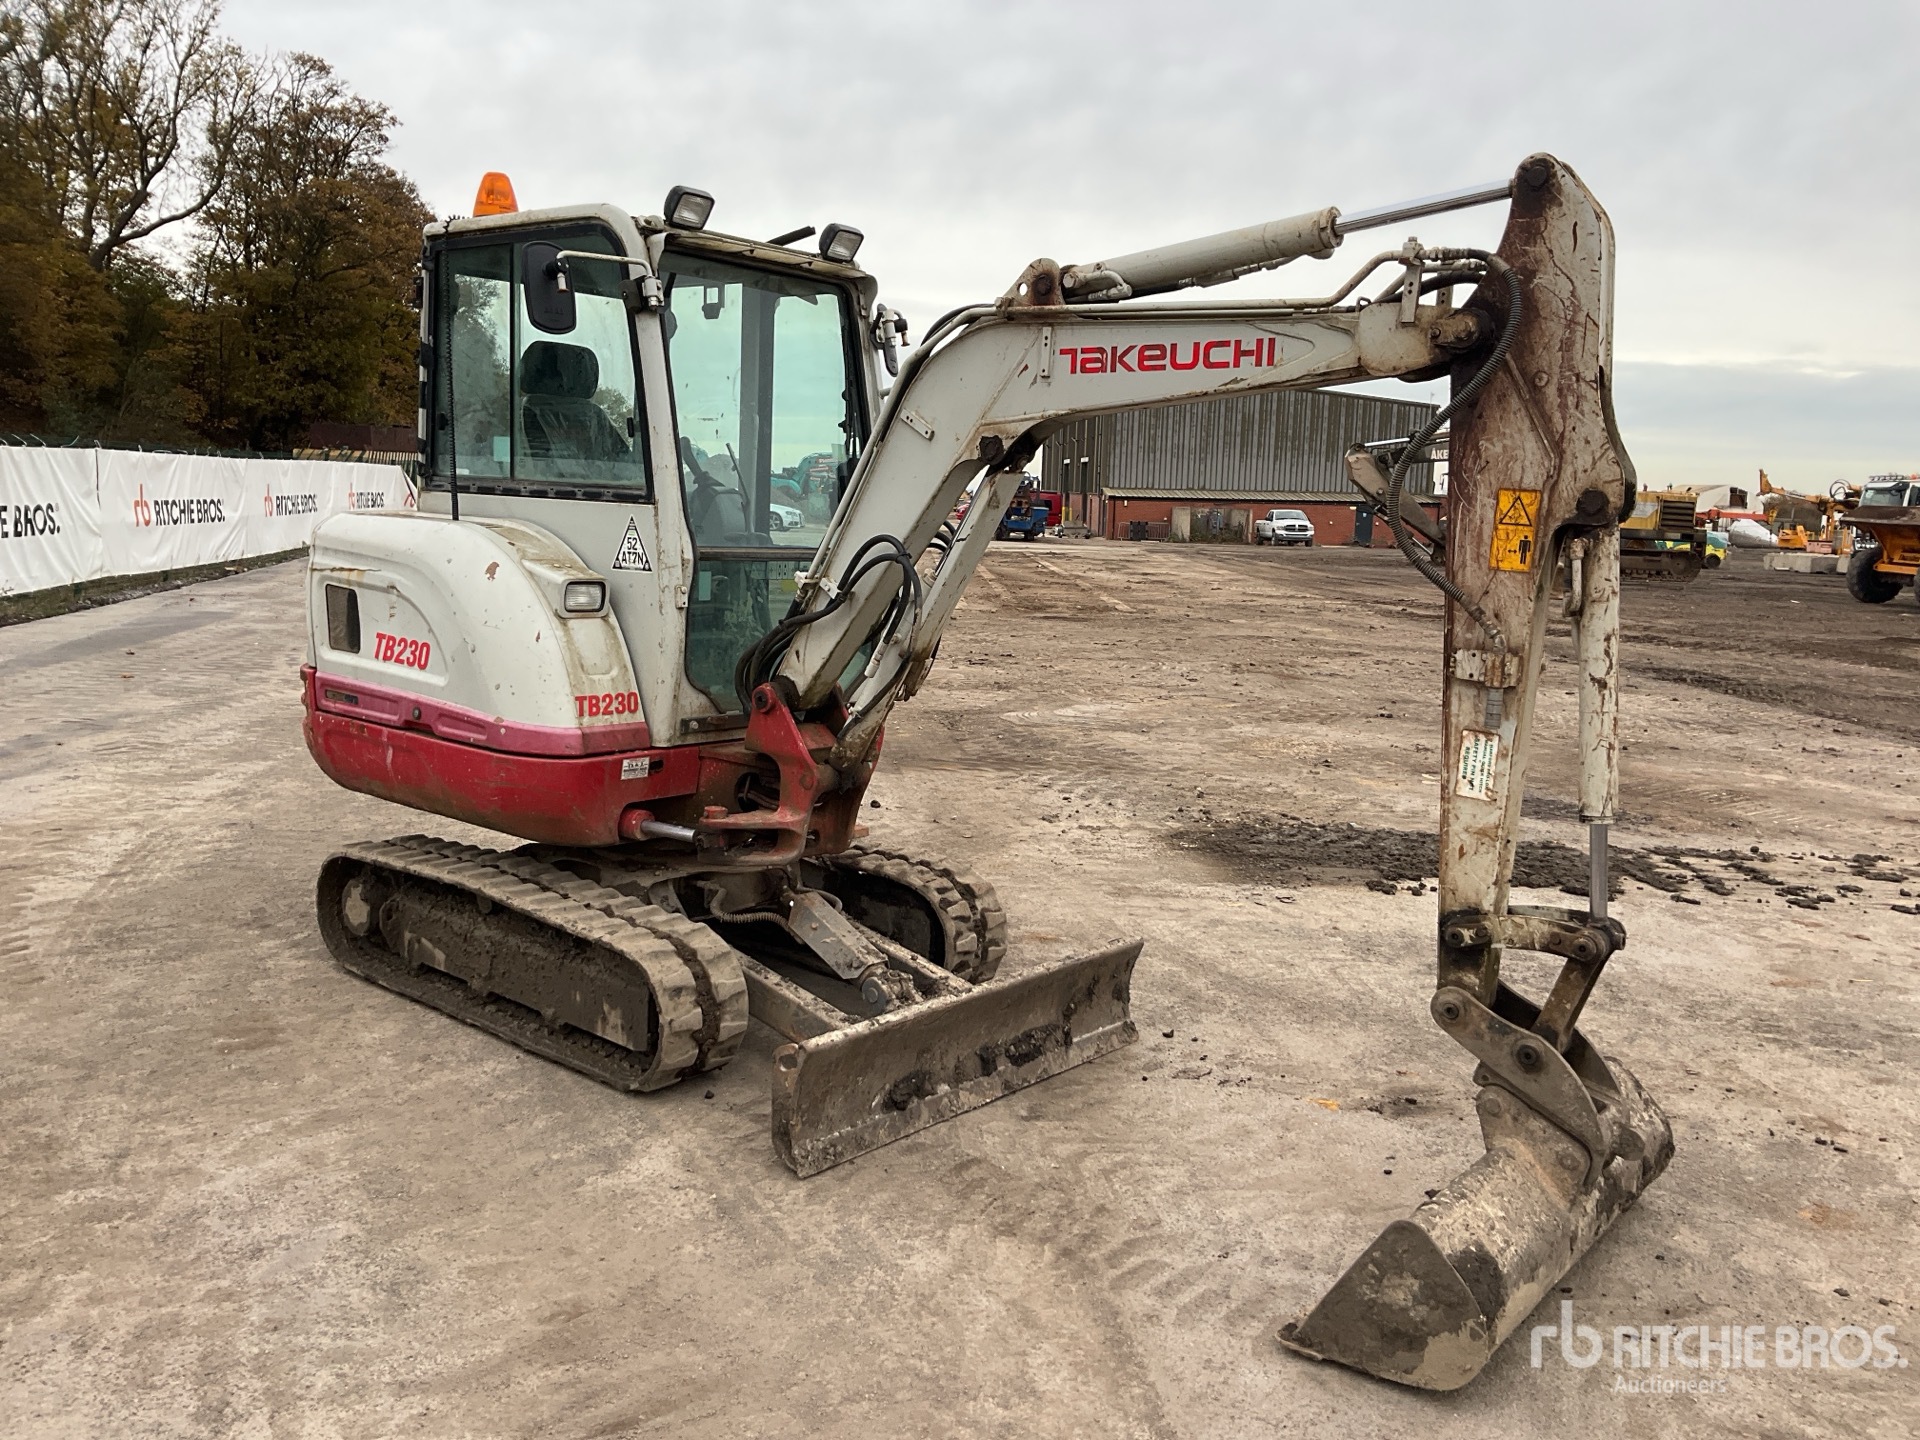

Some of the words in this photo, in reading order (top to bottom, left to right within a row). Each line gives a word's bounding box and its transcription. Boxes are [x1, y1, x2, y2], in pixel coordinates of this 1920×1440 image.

[153, 499, 195, 526] RITCHIE
[195, 498, 226, 524] BROS.
[275, 494, 301, 517] RITCHIE
[627, 536, 638, 551] 52
[374, 632, 431, 671] TB230
[575, 692, 640, 717] TB230
[1472, 738, 1480, 764] SAFETY
